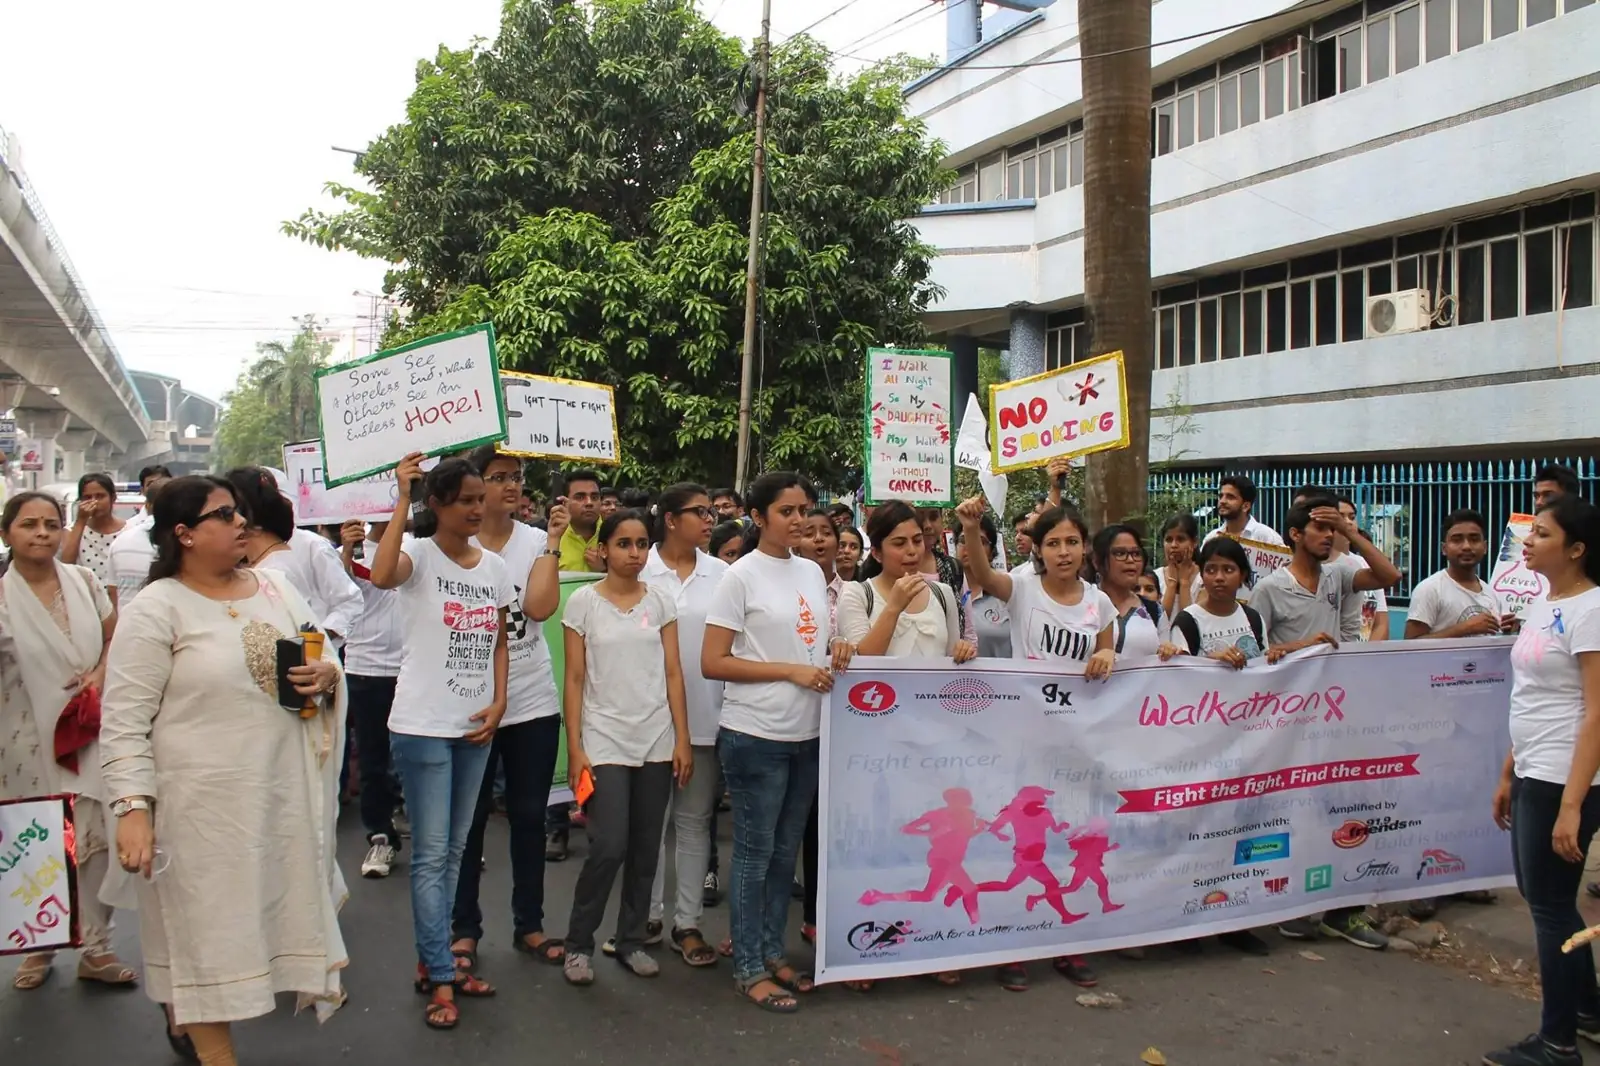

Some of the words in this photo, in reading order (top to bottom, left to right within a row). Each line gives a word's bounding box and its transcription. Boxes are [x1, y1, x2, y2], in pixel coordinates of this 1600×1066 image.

[349, 367, 392, 388] Some
[404, 353, 437, 371] See
[882, 358, 893, 370] I
[898, 360, 929, 372] Walk
[884, 374, 898, 384] All
[904, 375, 933, 391] Night
[345, 380, 401, 405] Hopeless
[888, 392, 900, 404] So
[910, 394, 926, 409] My
[343, 399, 397, 425] Others
[407, 389, 429, 403] See
[436, 382, 462, 396] An
[581, 401, 608, 415] FIGHT
[999, 396, 1048, 430] NO
[887, 410, 944, 425] DAUGHTER
[346, 418, 396, 441] Endless
[1002, 411, 1115, 458] SMOKING
[886, 432, 908, 448] May
[880, 452, 892, 462] In
[898, 451, 908, 463] A
[918, 452, 945, 465] World
[959, 451, 983, 472] Walk
[892, 467, 930, 477] WITHOUT
[437, 576, 456, 596] THE
[1501, 577, 1537, 587] NEVER
[1505, 593, 1534, 605] GIVE
[1509, 605, 1524, 614] UP
[1040, 622, 1092, 661] NOW
[448, 646, 473, 660] SINCE
[474, 647, 491, 661] 1998
[914, 692, 938, 701] TATA
[938, 691, 981, 701] MEDICAL
[981, 692, 1021, 702] CENTER
[845, 704, 878, 718] TECHNO
[879, 704, 901, 717] INDIA
[1138, 688, 1321, 727] Walkathon
[1242, 718, 1274, 732] walk
[1276, 717, 1293, 729] for
[1293, 714, 1318, 727] hope
[1346, 724, 1358, 736] is
[1362, 723, 1385, 736] not
[1389, 722, 1406, 733] an
[846, 752, 913, 774] Fight
[919, 754, 1002, 770] cancer
[1053, 766, 1103, 784] Fight
[1108, 766, 1161, 782] cancer
[1163, 759, 1198, 775] with
[1202, 756, 1243, 772] hope
[1153, 787, 1207, 808] Fight
[1210, 782, 1239, 799] the
[1244, 774, 1286, 796] fight,
[1290, 765, 1328, 785] Find
[1331, 763, 1361, 779] the
[1366, 761, 1404, 776] cure
[1328, 802, 1382, 815] Amplified
[1384, 801, 1397, 810] by
[1188, 832, 1200, 842] In
[1203, 823, 1261, 840] association
[1263, 817, 1290, 829] with:
[1349, 820, 1408, 839] friends
[1408, 819, 1422, 828] fm
[1366, 816, 1392, 826] 91.9
[1162, 860, 1192, 877] will
[1193, 868, 1250, 888] Supported
[1252, 867, 1270, 879] by:
[10, 855, 66, 907] HOPE
[7, 893, 70, 949] LOVE
[913, 929, 945, 944] walk
[946, 927, 966, 941] for
[967, 930, 976, 938] a
[978, 923, 1015, 937] better
[1016, 920, 1054, 934] world
